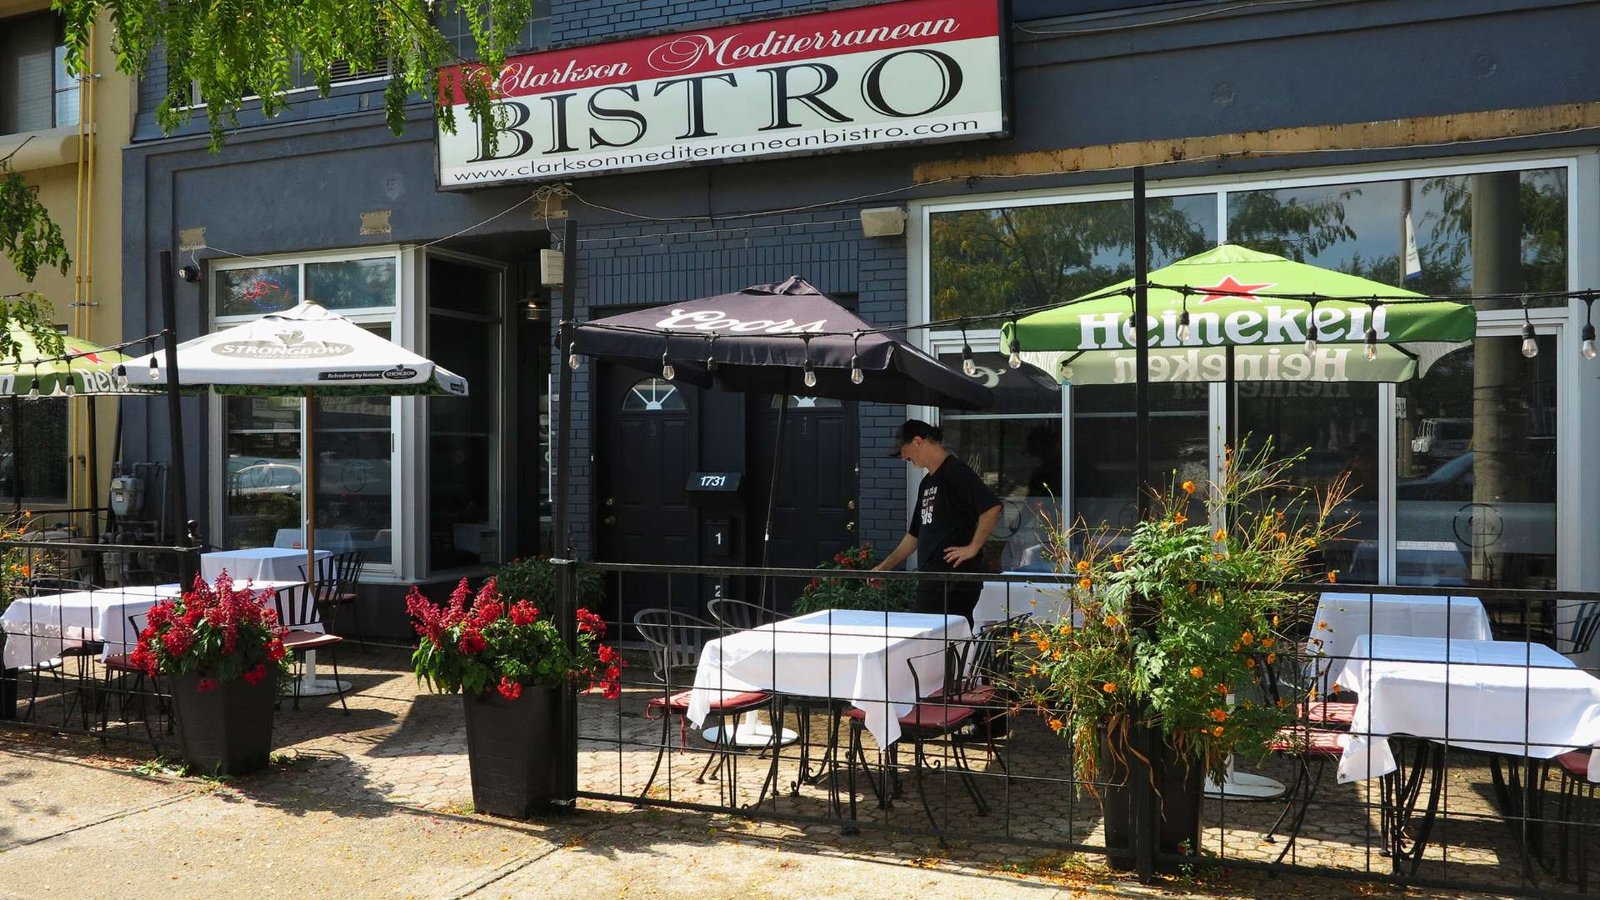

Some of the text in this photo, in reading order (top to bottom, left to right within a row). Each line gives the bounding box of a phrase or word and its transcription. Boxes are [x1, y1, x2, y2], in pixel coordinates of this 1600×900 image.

[647, 18, 960, 72] Mediterranean
[467, 49, 963, 163] BISTRO
[454, 120, 978, 181] www.clarksonmediterraneanbistro.com
[656, 308, 828, 333] Coors
[1077, 304, 1390, 349] Heineken
[222, 344, 347, 355] STRONGBOW
[700, 476, 726, 487] 1731
[715, 532, 722, 545] 1
[715, 585, 722, 597] 2
